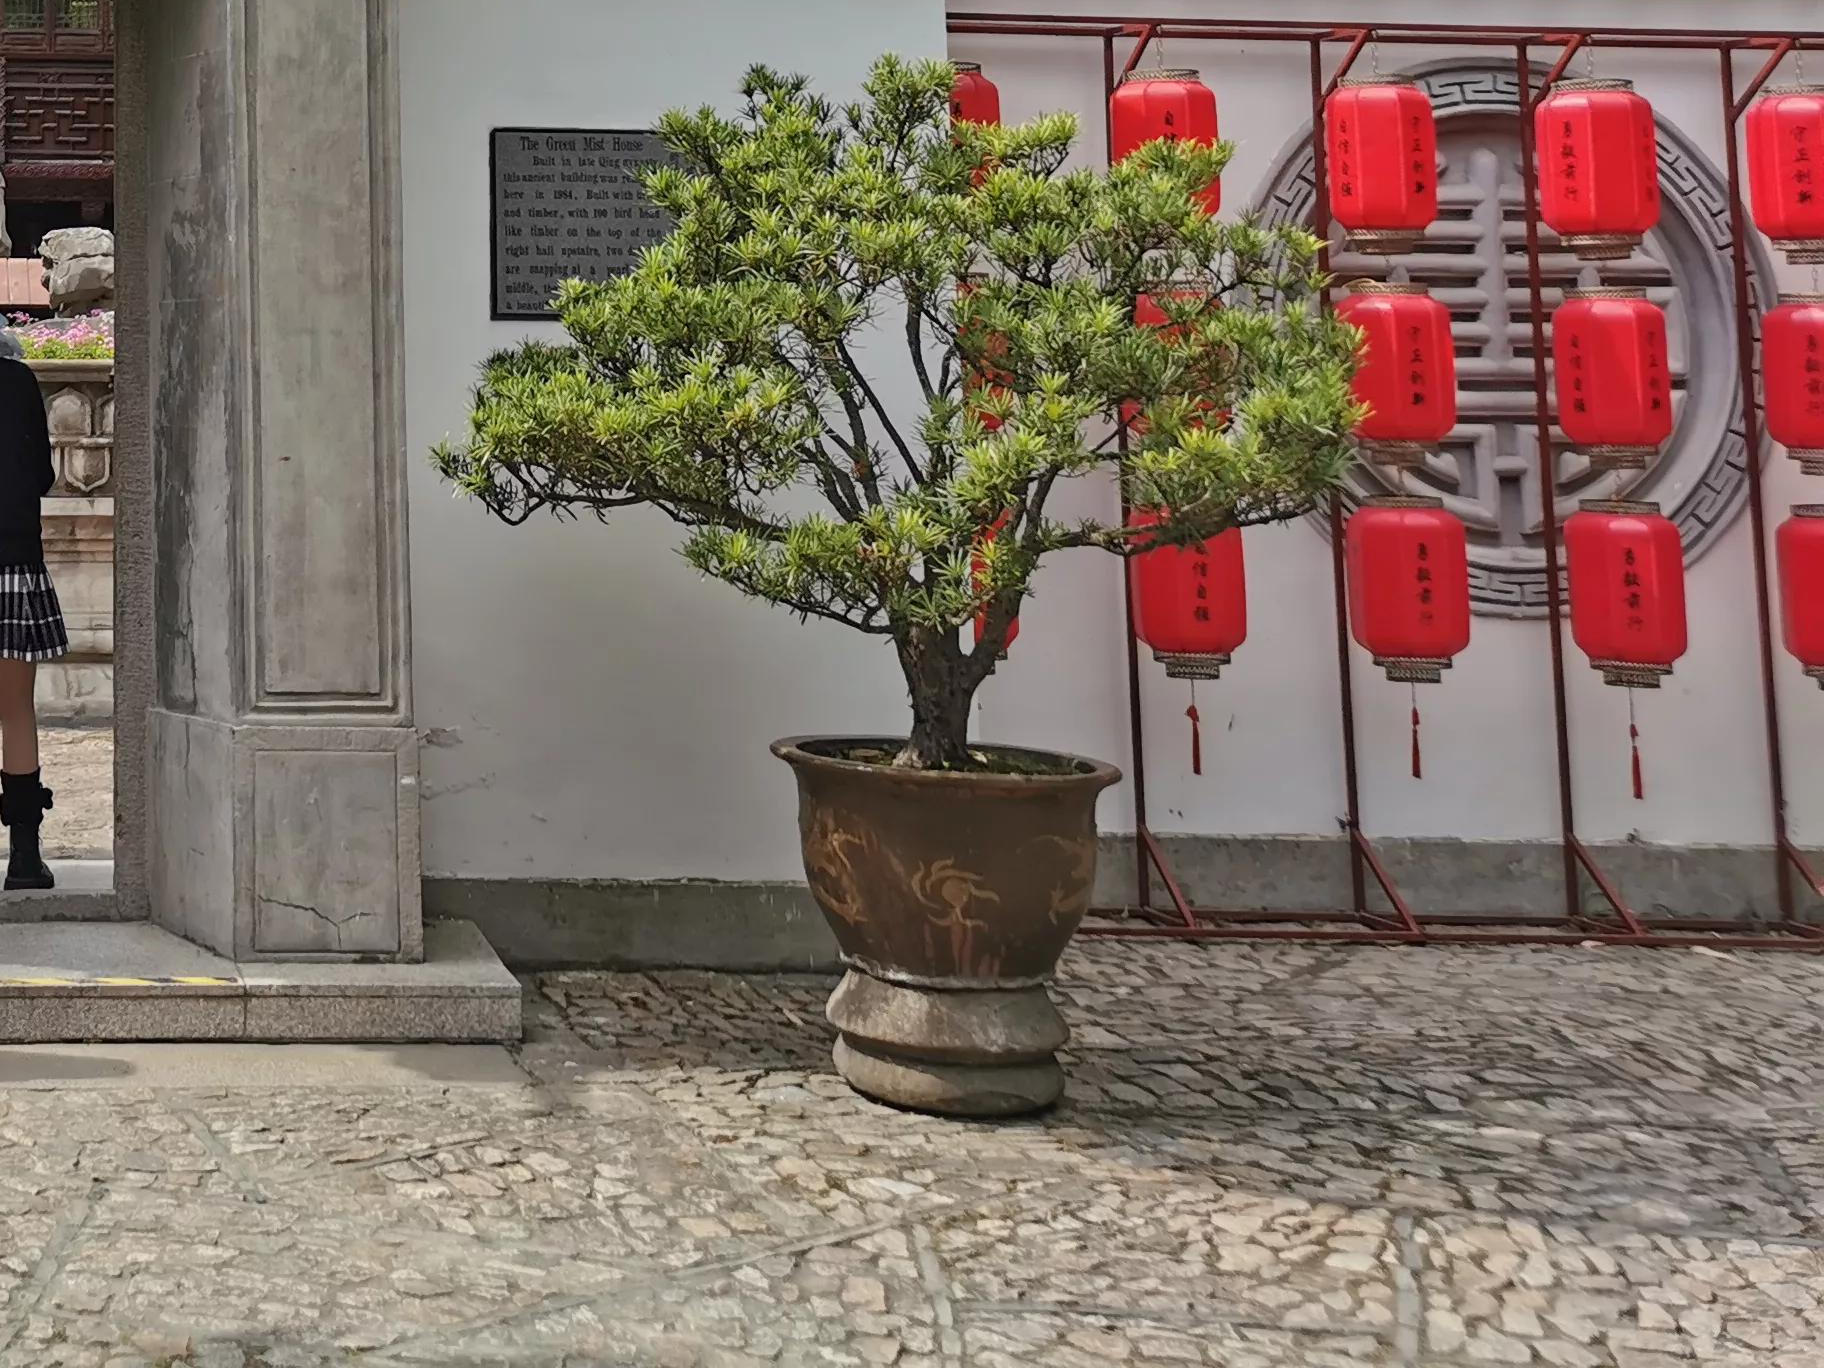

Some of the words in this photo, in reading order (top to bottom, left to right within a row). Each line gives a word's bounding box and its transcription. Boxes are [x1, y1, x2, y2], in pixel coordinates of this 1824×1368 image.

[520, 136, 540, 151] The
[546, 136, 577, 151] Green
[583, 136, 606, 151] Mist
[612, 137, 644, 151] House
[533, 156, 556, 167] Built
[560, 172, 599, 185] building
[586, 189, 610, 200] Built
[612, 190, 634, 200] with
[503, 208, 522, 219] and
[567, 208, 589, 218] with
[504, 225, 523, 237] like
[530, 224, 560, 237] timber
[586, 225, 602, 237] the
[608, 225, 624, 240] top
[630, 225, 640, 237] of
[505, 244, 530, 258] right
[504, 264, 521, 275] are
